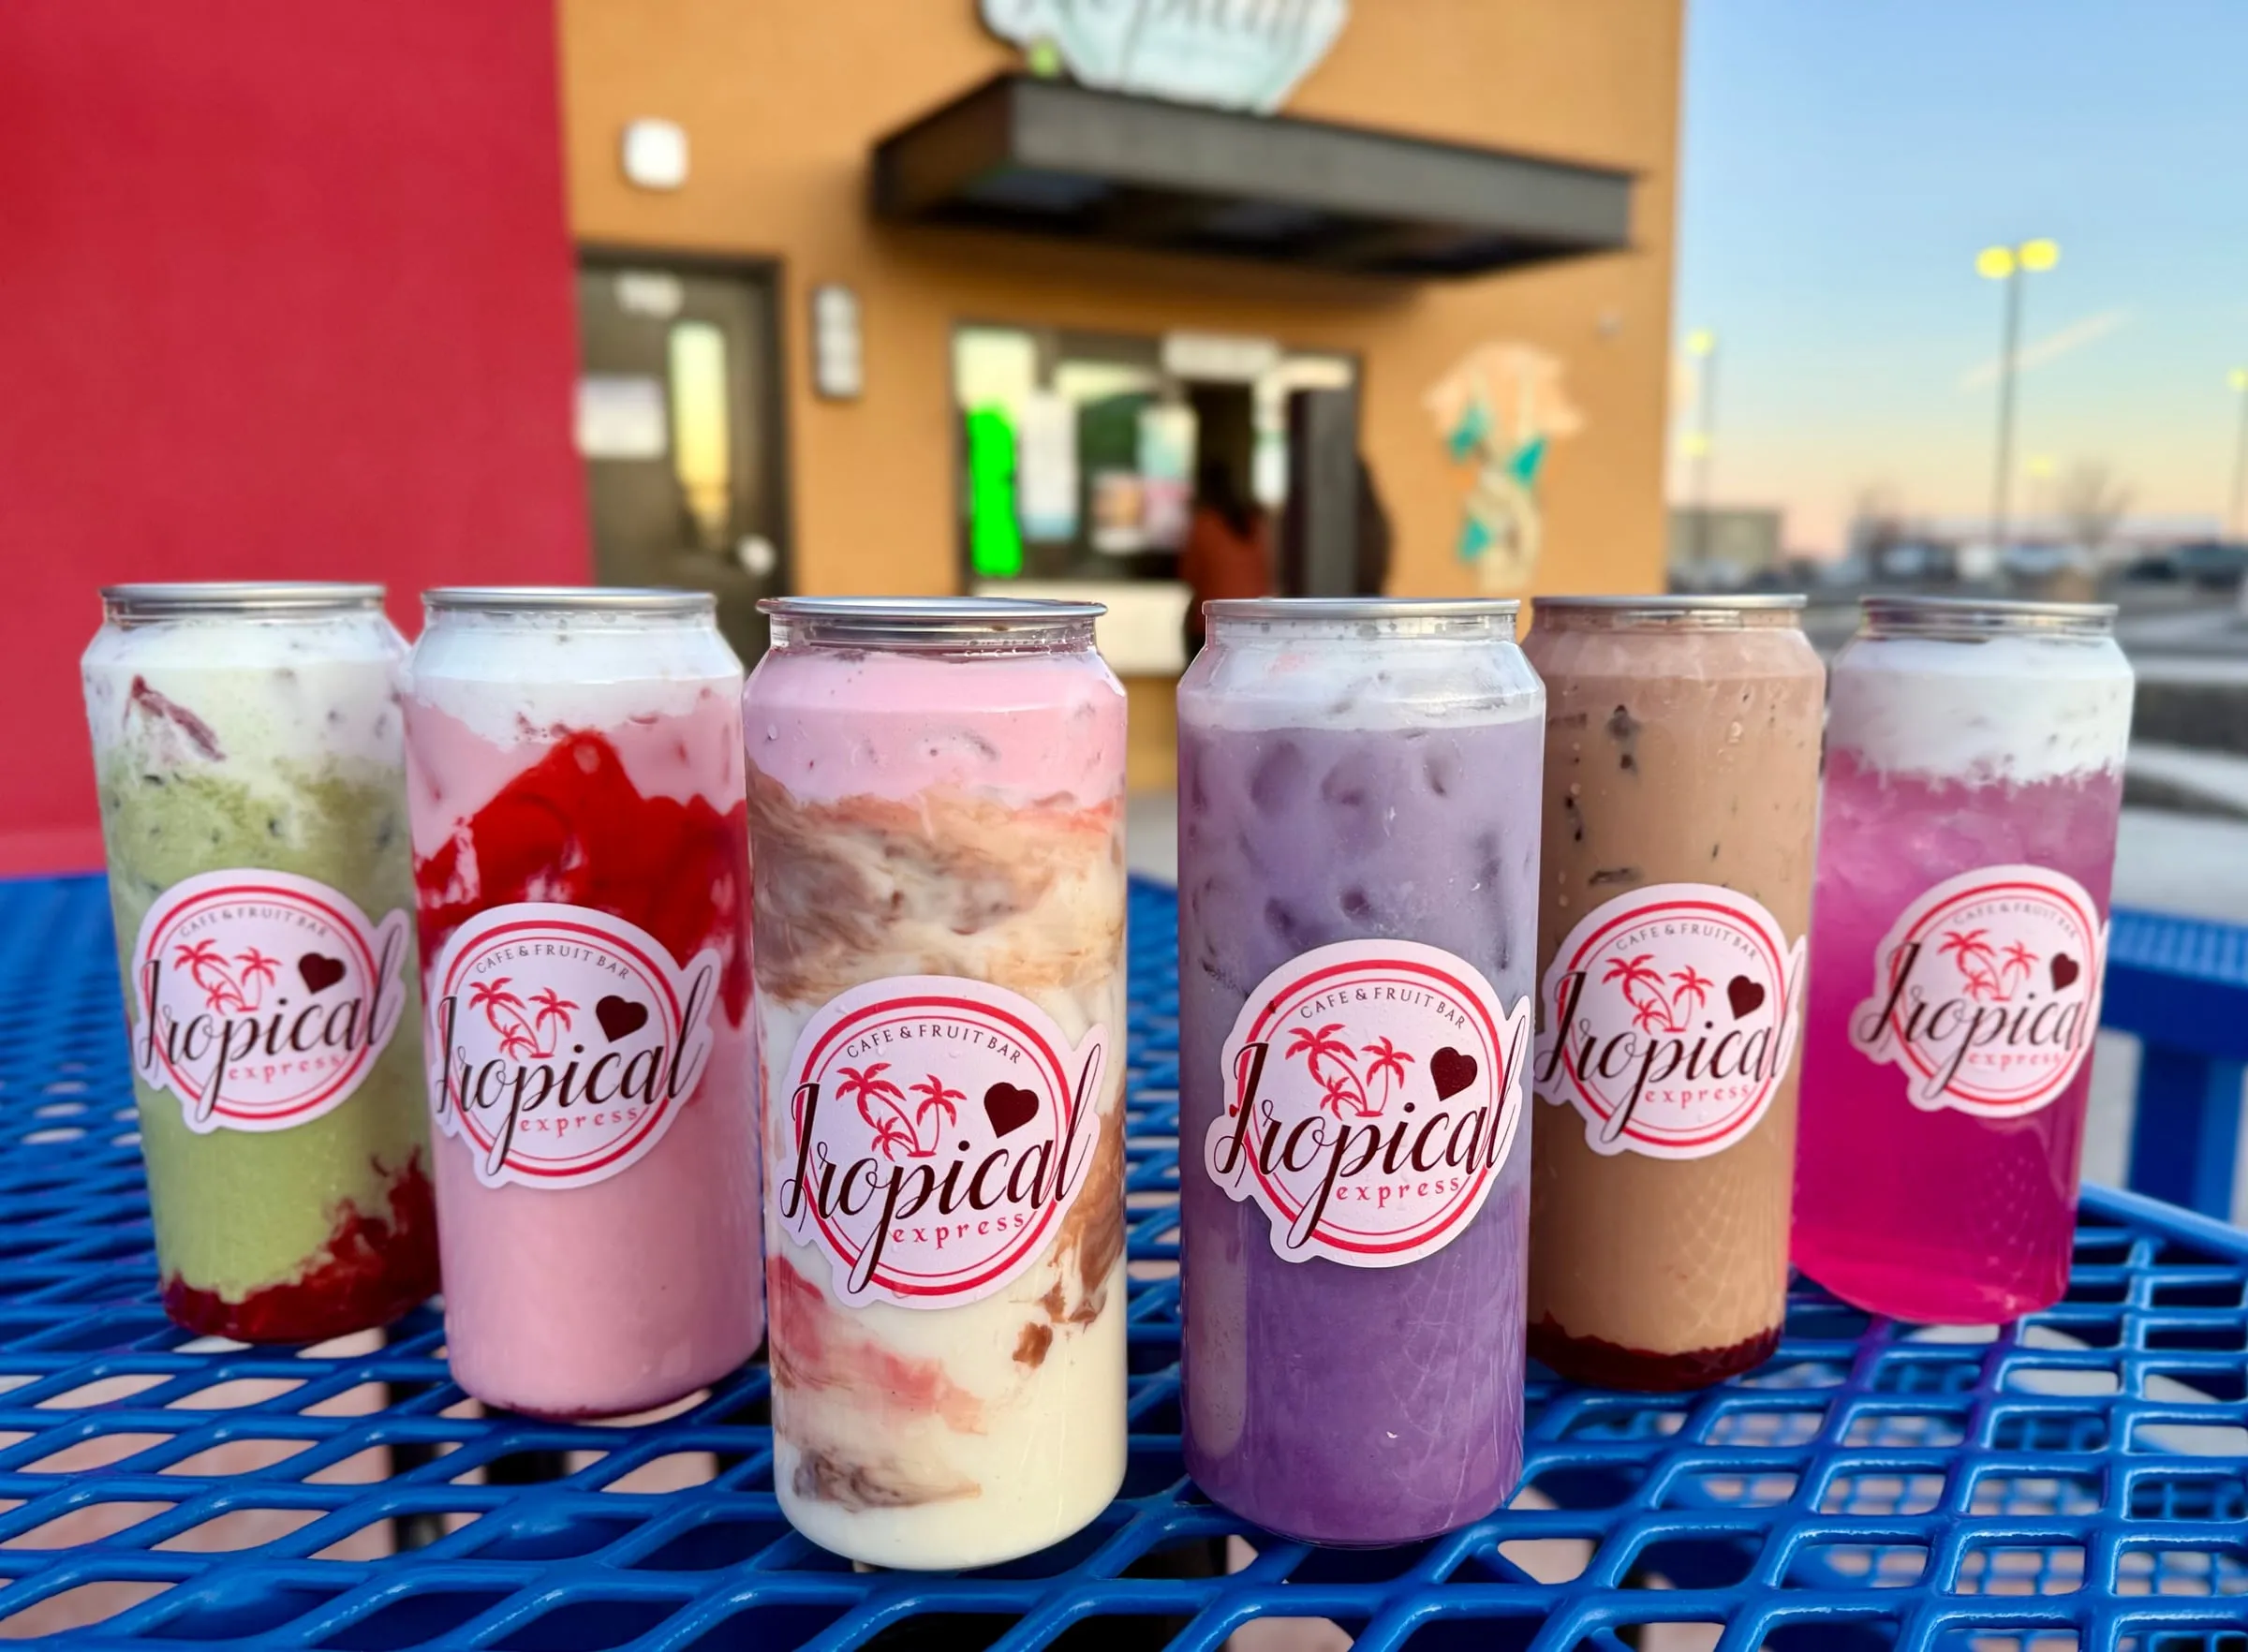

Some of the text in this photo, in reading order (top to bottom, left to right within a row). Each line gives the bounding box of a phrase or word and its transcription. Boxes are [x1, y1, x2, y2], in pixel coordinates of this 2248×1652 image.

[180, 907, 327, 937] CAFE & FRUIT BAR
[1616, 923, 1757, 962] CAFE & FRUIT BAR
[476, 945, 630, 980] CAFE & FRUIT BAR
[139, 923, 403, 1123] Tropical
[1300, 987, 1466, 1030] CAFE & FRUIT BAR
[847, 1025, 1022, 1064] CAFE & FRUIT BAR
[1533, 951, 1804, 1144] Tropical
[229, 1056, 343, 1084] express
[436, 965, 713, 1177] Tropical
[1645, 1084, 1750, 1109] express
[521, 1107, 638, 1138] express
[1214, 1015, 1526, 1249] Tropical
[780, 1043, 1101, 1293] Tropical
[1336, 1176, 1460, 1209] express
[892, 1213, 1025, 1250] express
